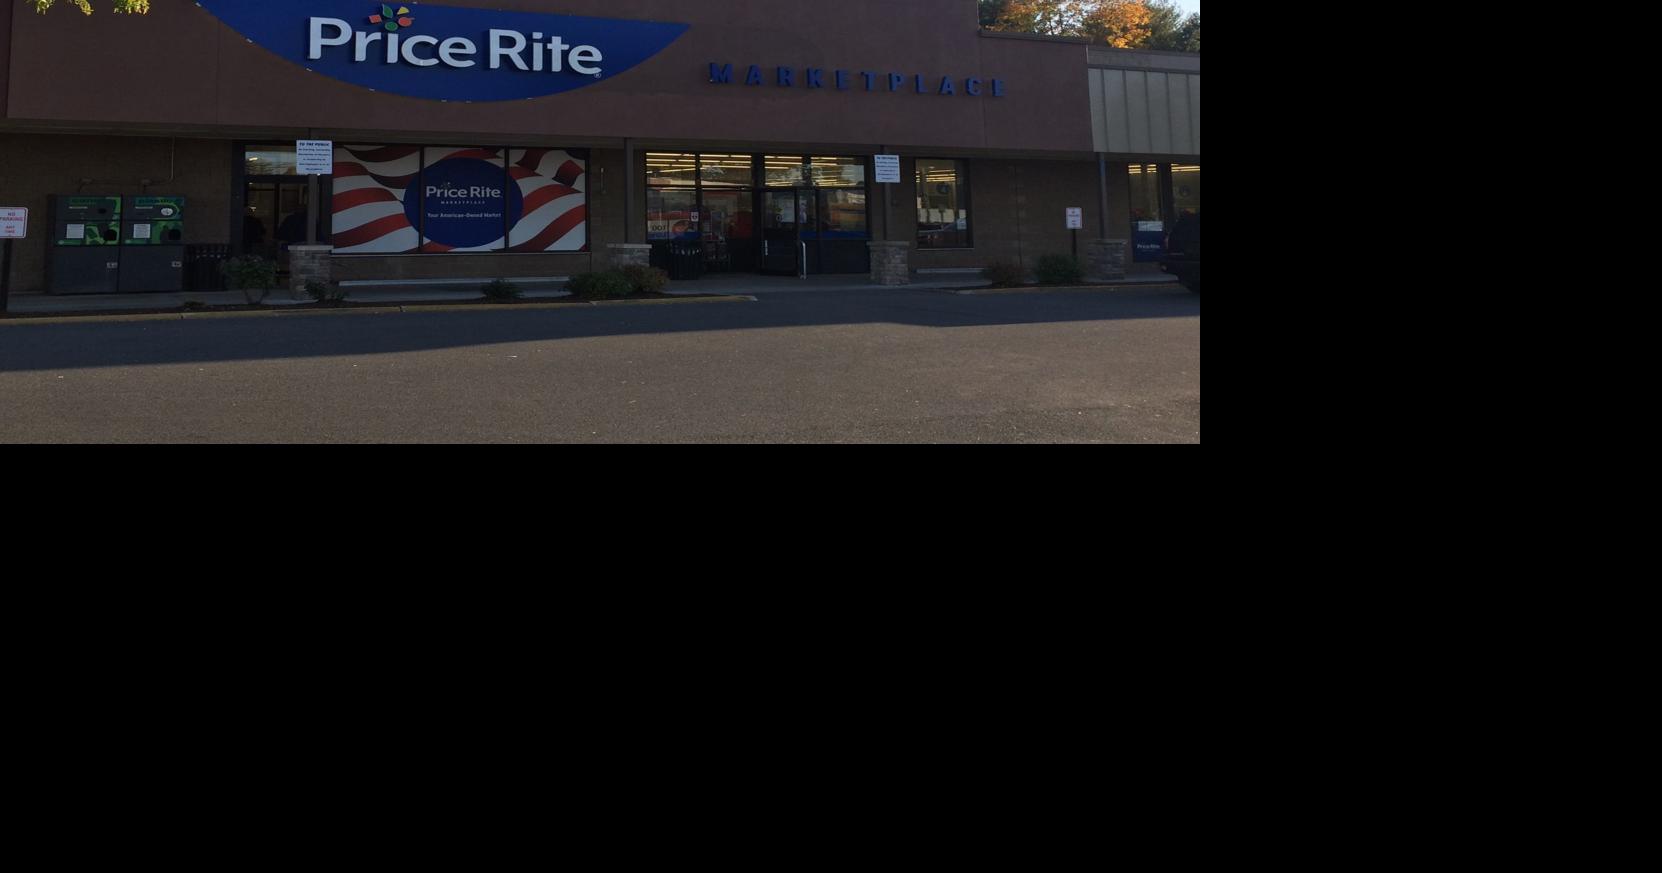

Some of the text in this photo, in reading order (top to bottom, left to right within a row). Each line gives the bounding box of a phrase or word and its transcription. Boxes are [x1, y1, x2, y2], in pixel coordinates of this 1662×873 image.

[309, 16, 603, 75] Price Rite
[708, 62, 1006, 98] MARKETPLACE
[426, 185, 501, 198] Price Rite
